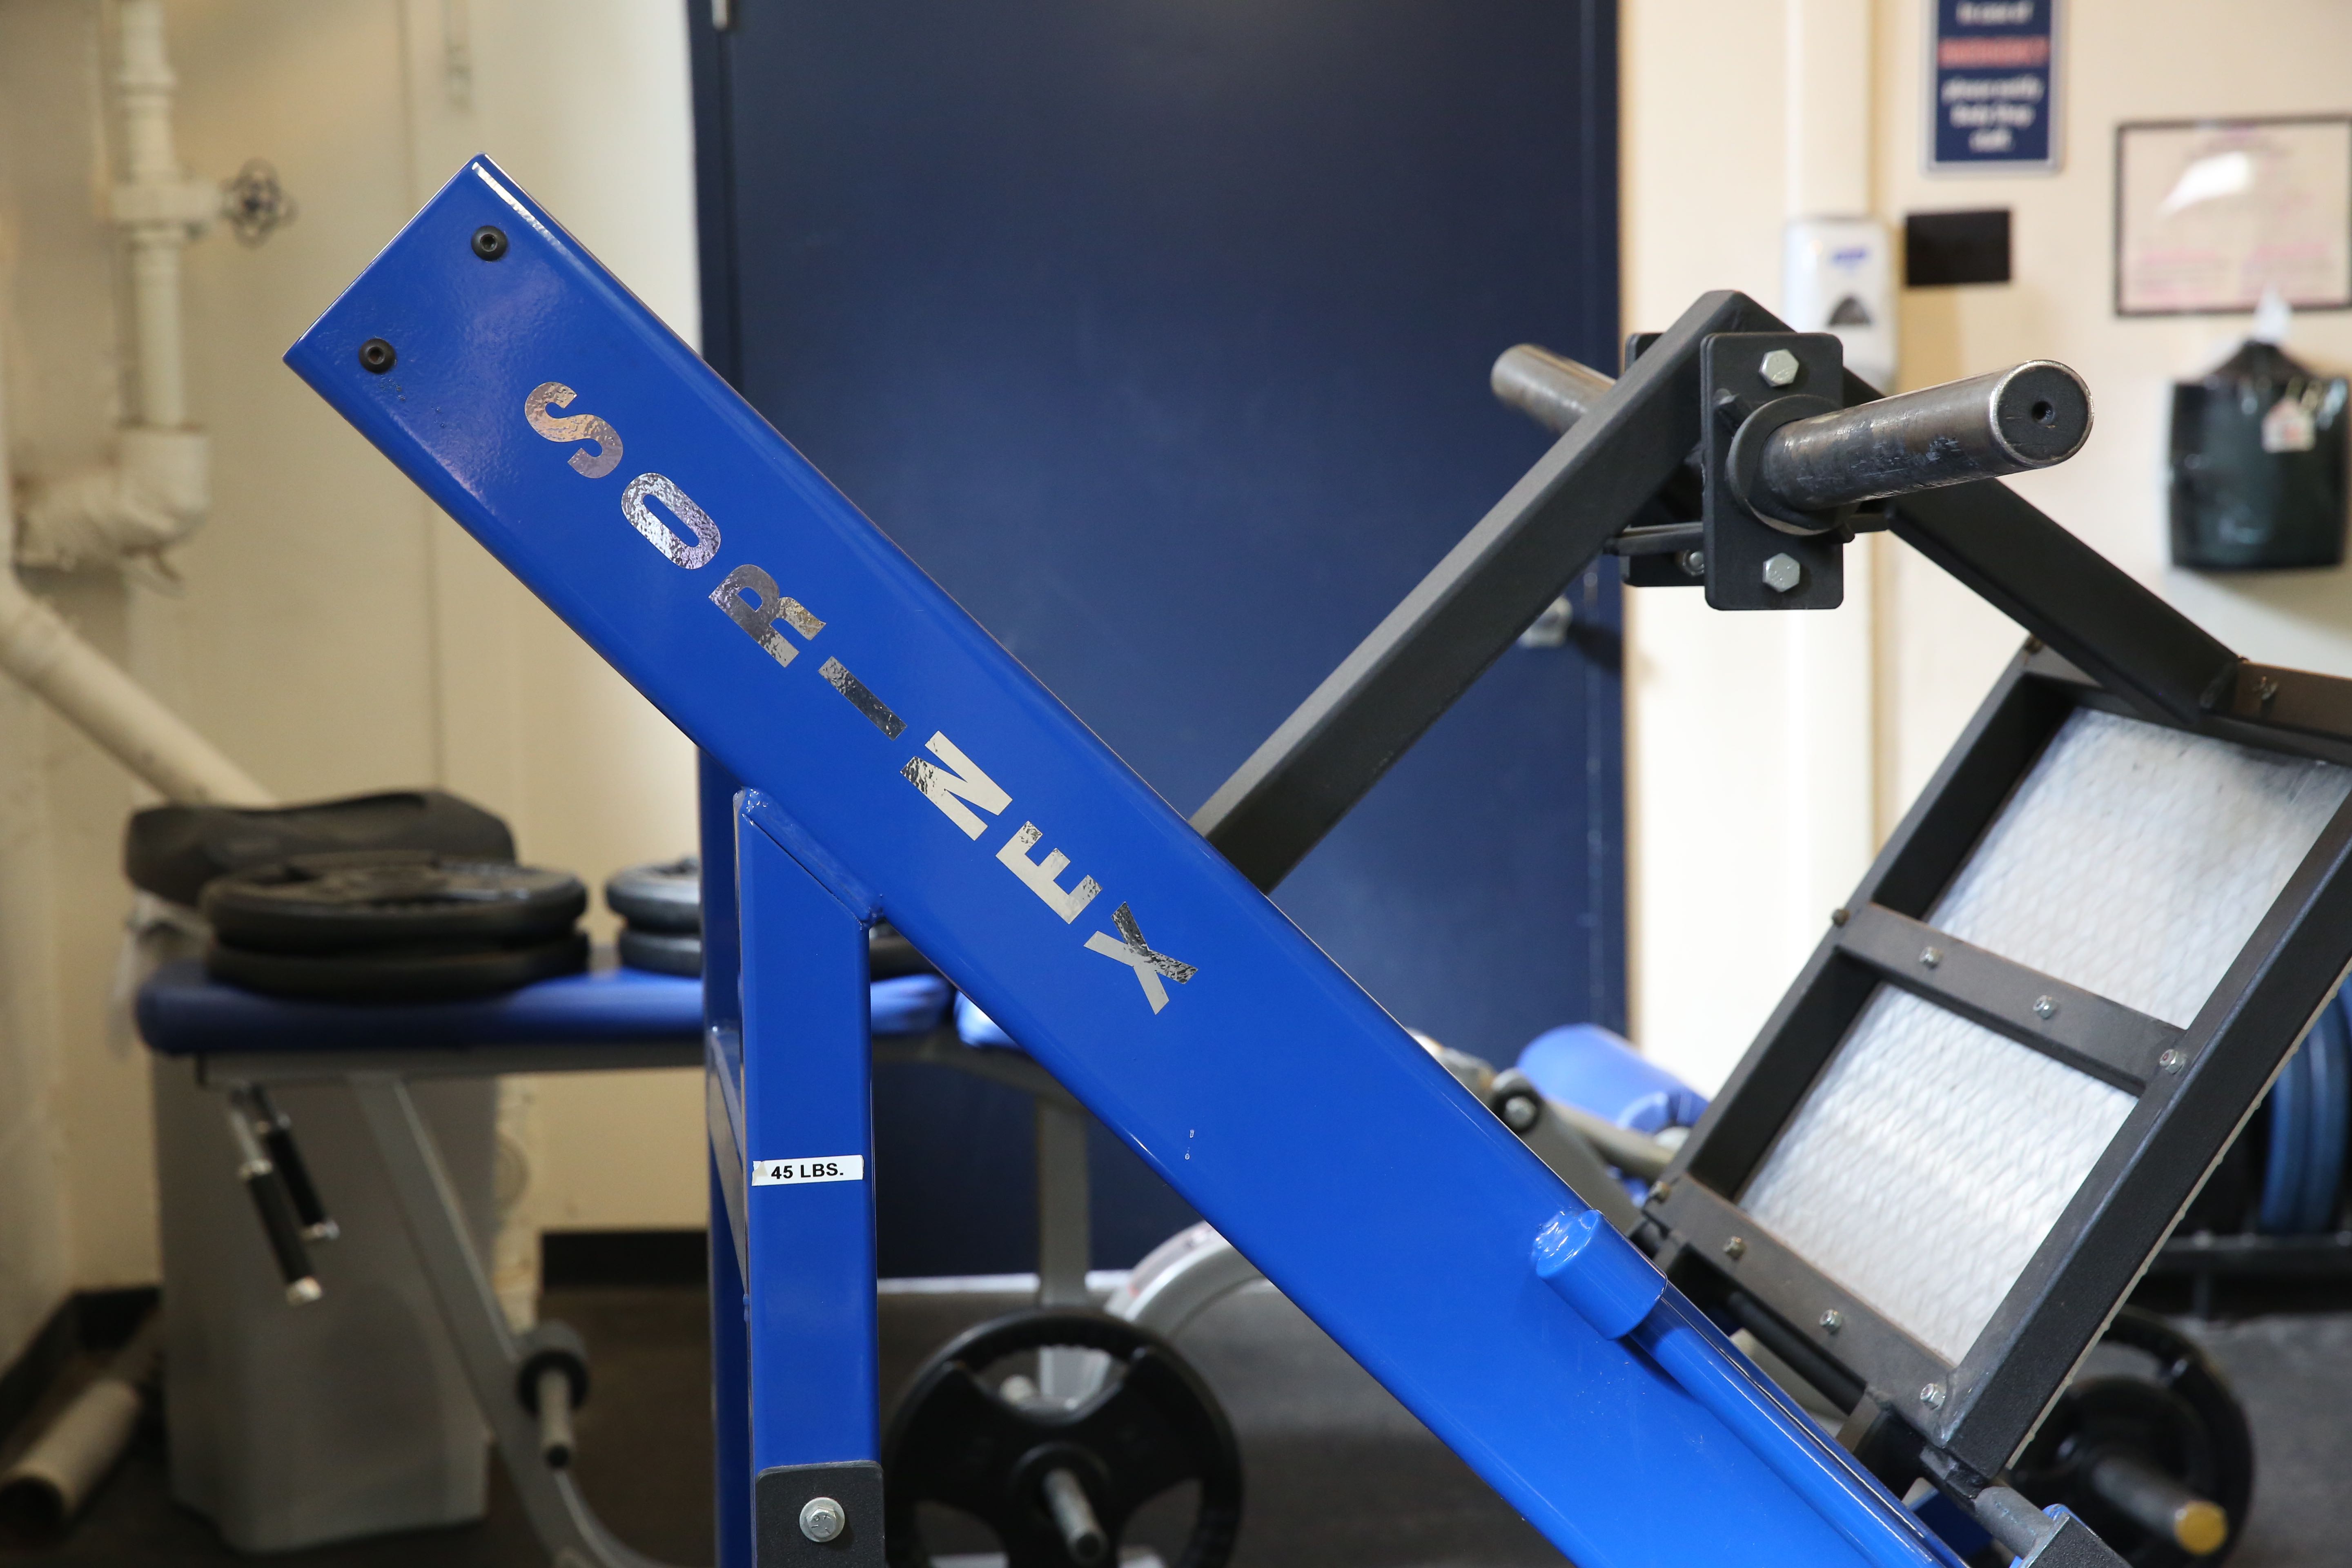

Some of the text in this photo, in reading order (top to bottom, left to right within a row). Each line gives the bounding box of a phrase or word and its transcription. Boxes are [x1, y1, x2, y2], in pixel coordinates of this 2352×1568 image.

[524, 381, 1198, 1015] SORINEX
[771, 1163, 844, 1179] 45 LBS.
